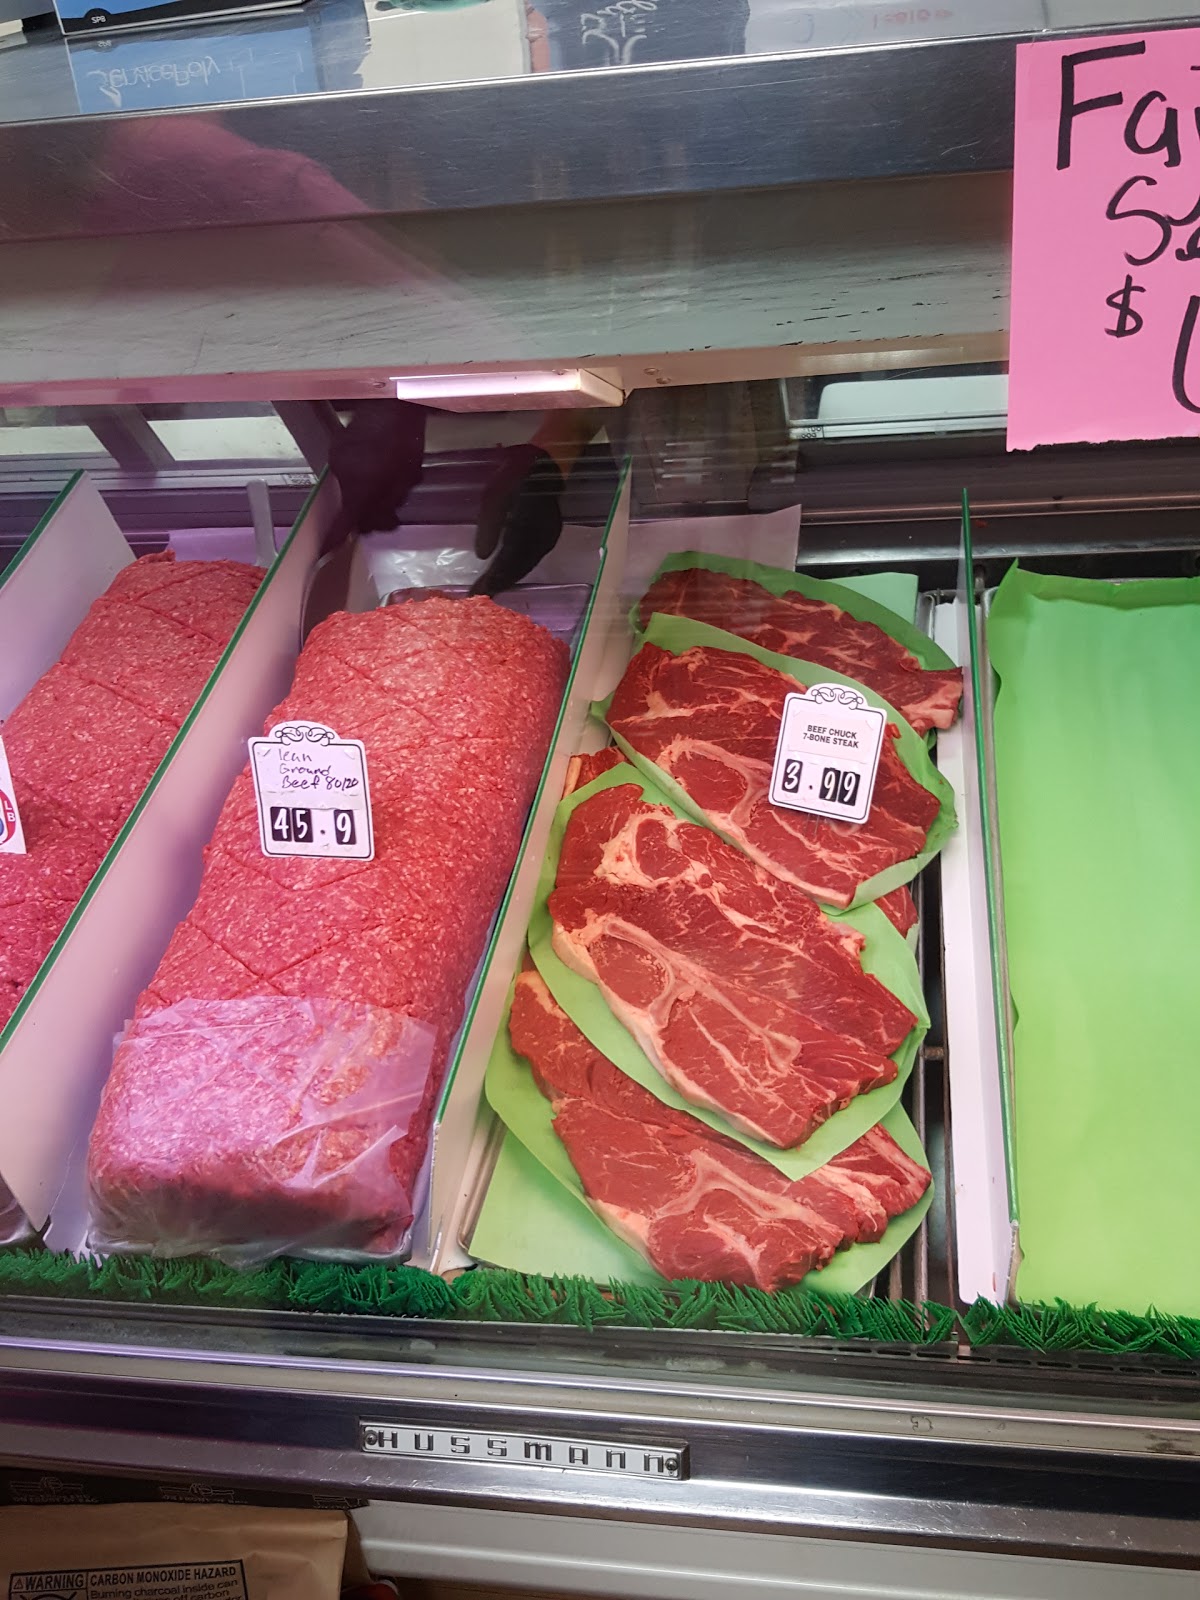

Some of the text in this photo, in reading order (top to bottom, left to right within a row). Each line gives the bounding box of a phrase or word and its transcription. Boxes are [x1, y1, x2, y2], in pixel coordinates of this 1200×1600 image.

[1057, 40, 1200, 170] Fa
[803, 732, 860, 749] 7-BONE STEAK
[807, 724, 858, 740] BEEF CHUCK
[280, 763, 332, 776] Ground
[282, 775, 320, 790] Beef
[25, 1574, 85, 1591] WARNING
[90, 1566, 237, 1587] CARBON MONOXIDE HAZARD
[134, 1585, 180, 1597] charcoal
[182, 1583, 215, 1594] inside
[217, 1579, 238, 1589] can
